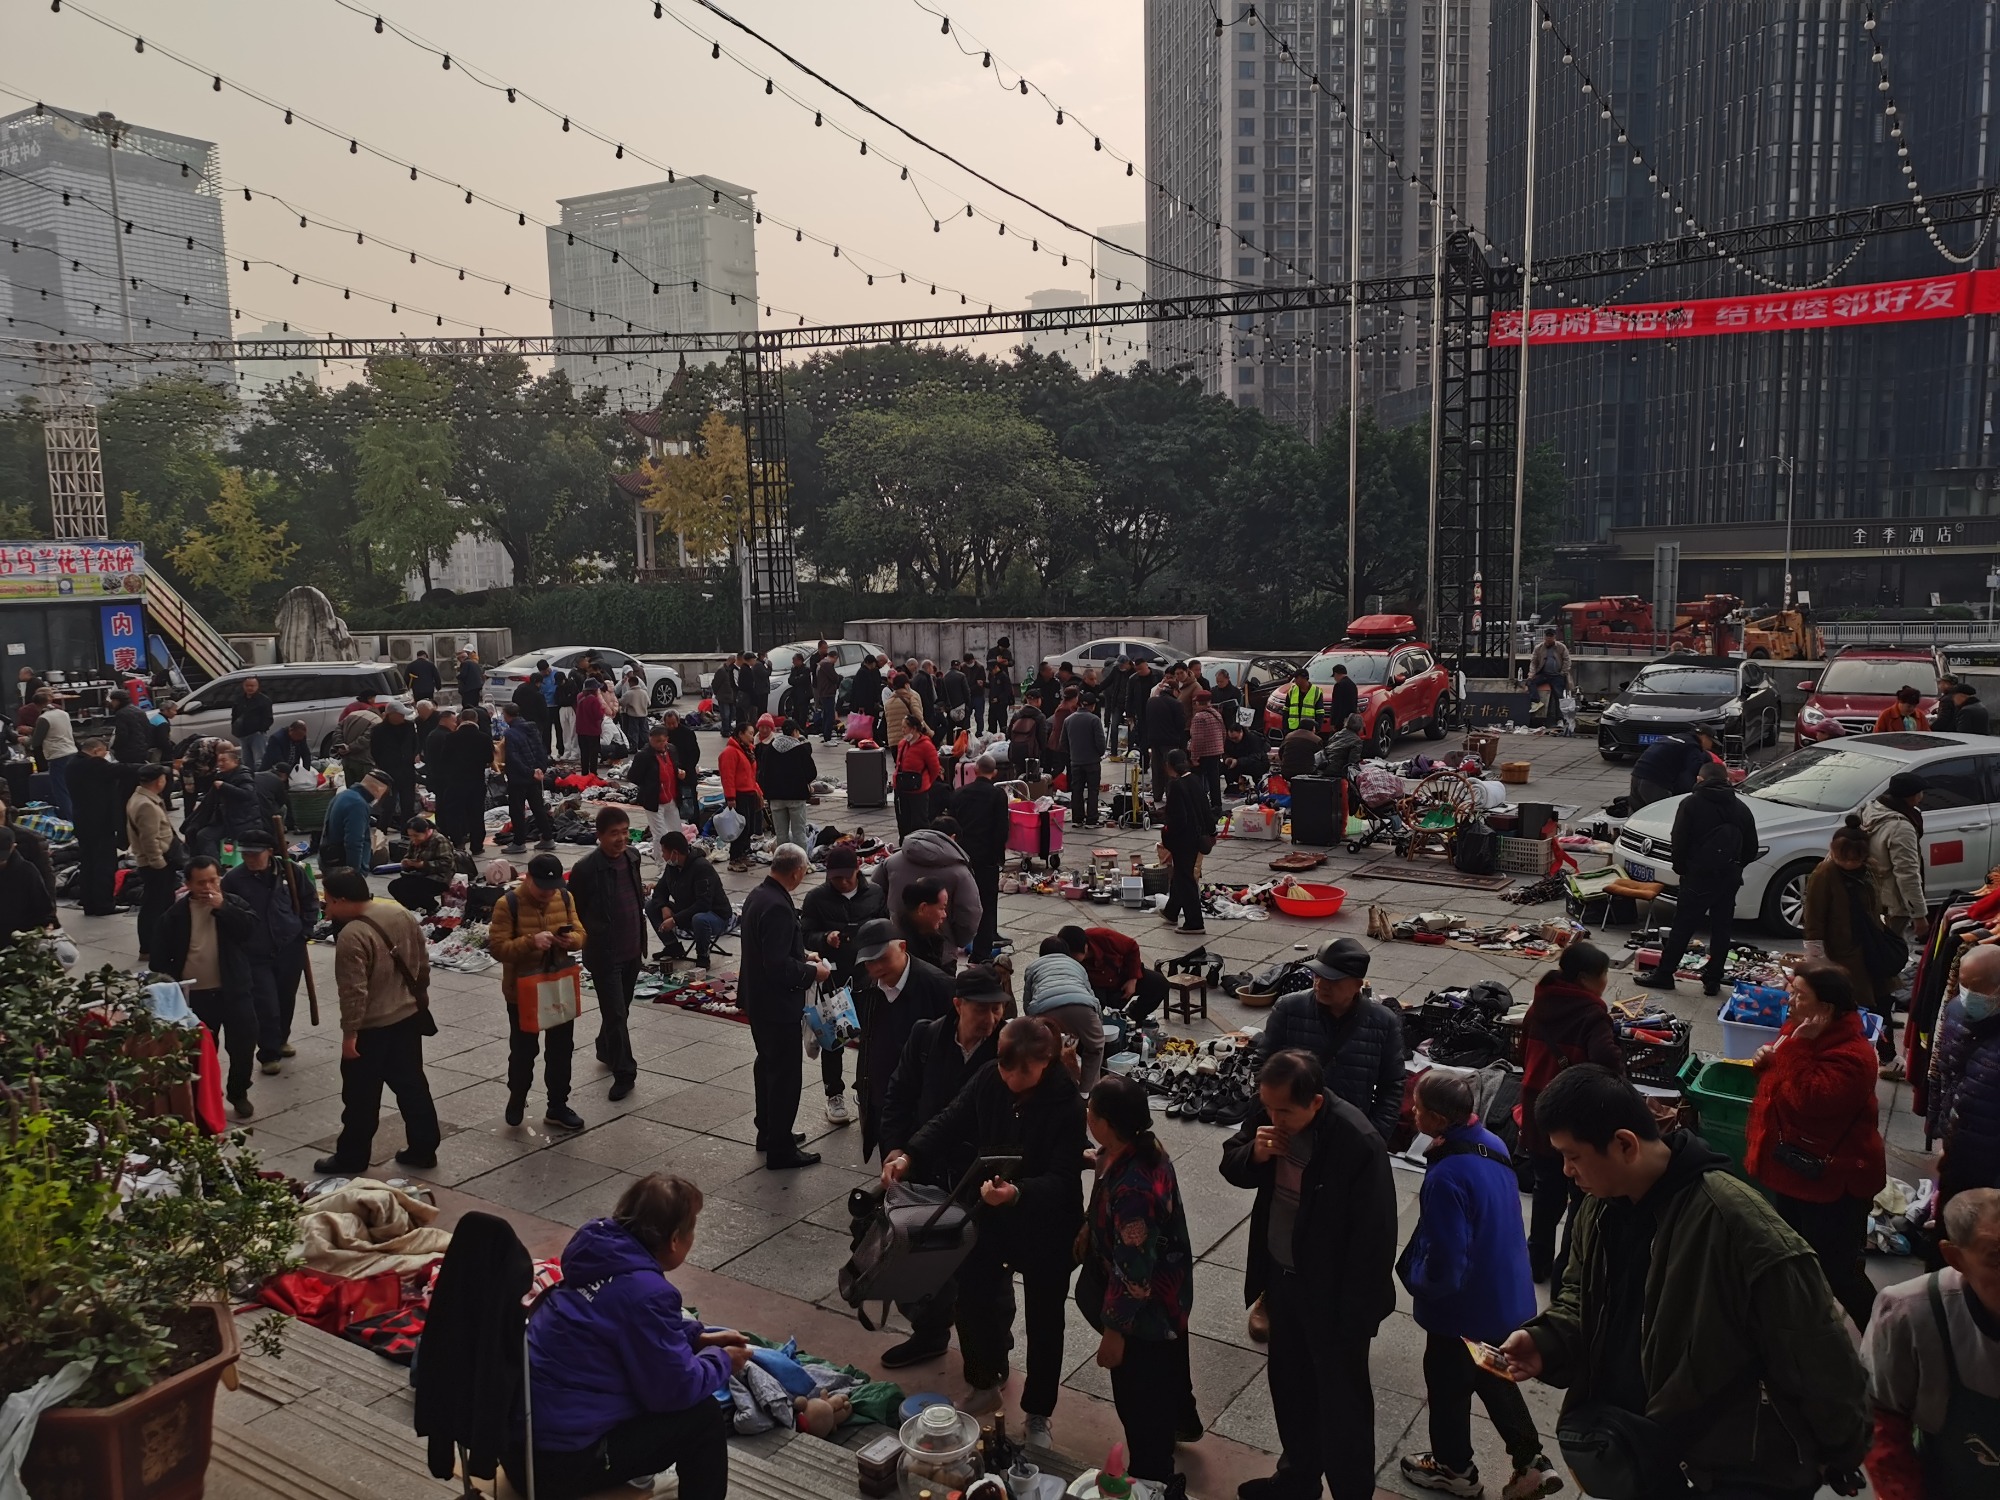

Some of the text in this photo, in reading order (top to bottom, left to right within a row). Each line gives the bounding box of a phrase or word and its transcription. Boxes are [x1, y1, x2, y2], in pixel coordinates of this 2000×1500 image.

[0, 140, 41, 167] 开发中心
[1715, 281, 1958, 326] 结识睦邻好友
[1852, 525, 1952, 545] 全季酒店
[1898, 547, 1936, 555] HOTEL
[111, 612, 137, 671] 内蒙
[1462, 704, 1510, 718] 江北店
